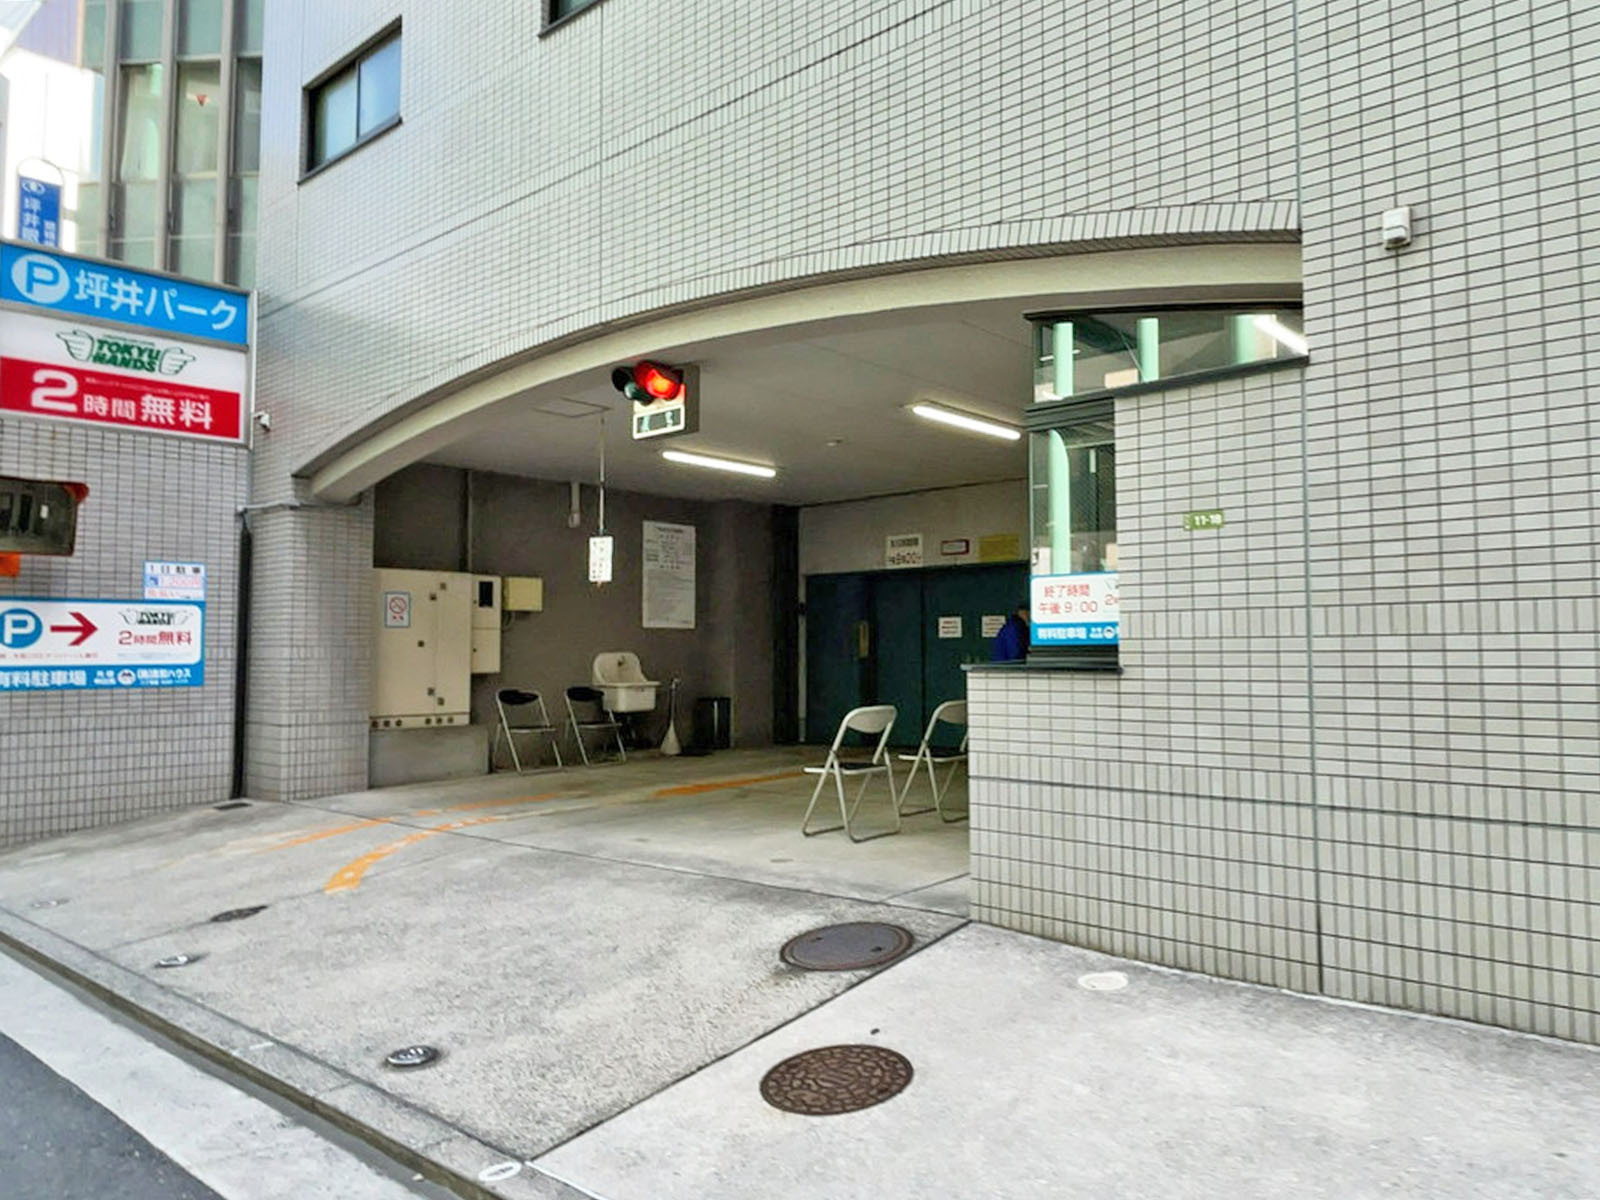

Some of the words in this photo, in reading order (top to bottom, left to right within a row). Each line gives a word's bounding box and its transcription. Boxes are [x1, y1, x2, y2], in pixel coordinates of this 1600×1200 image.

[74, 269, 237, 331] 坪井パーク
[92, 353, 156, 373] HANDS
[97, 339, 161, 360] TOKYU
[31, 369, 213, 430] 2時間無料
